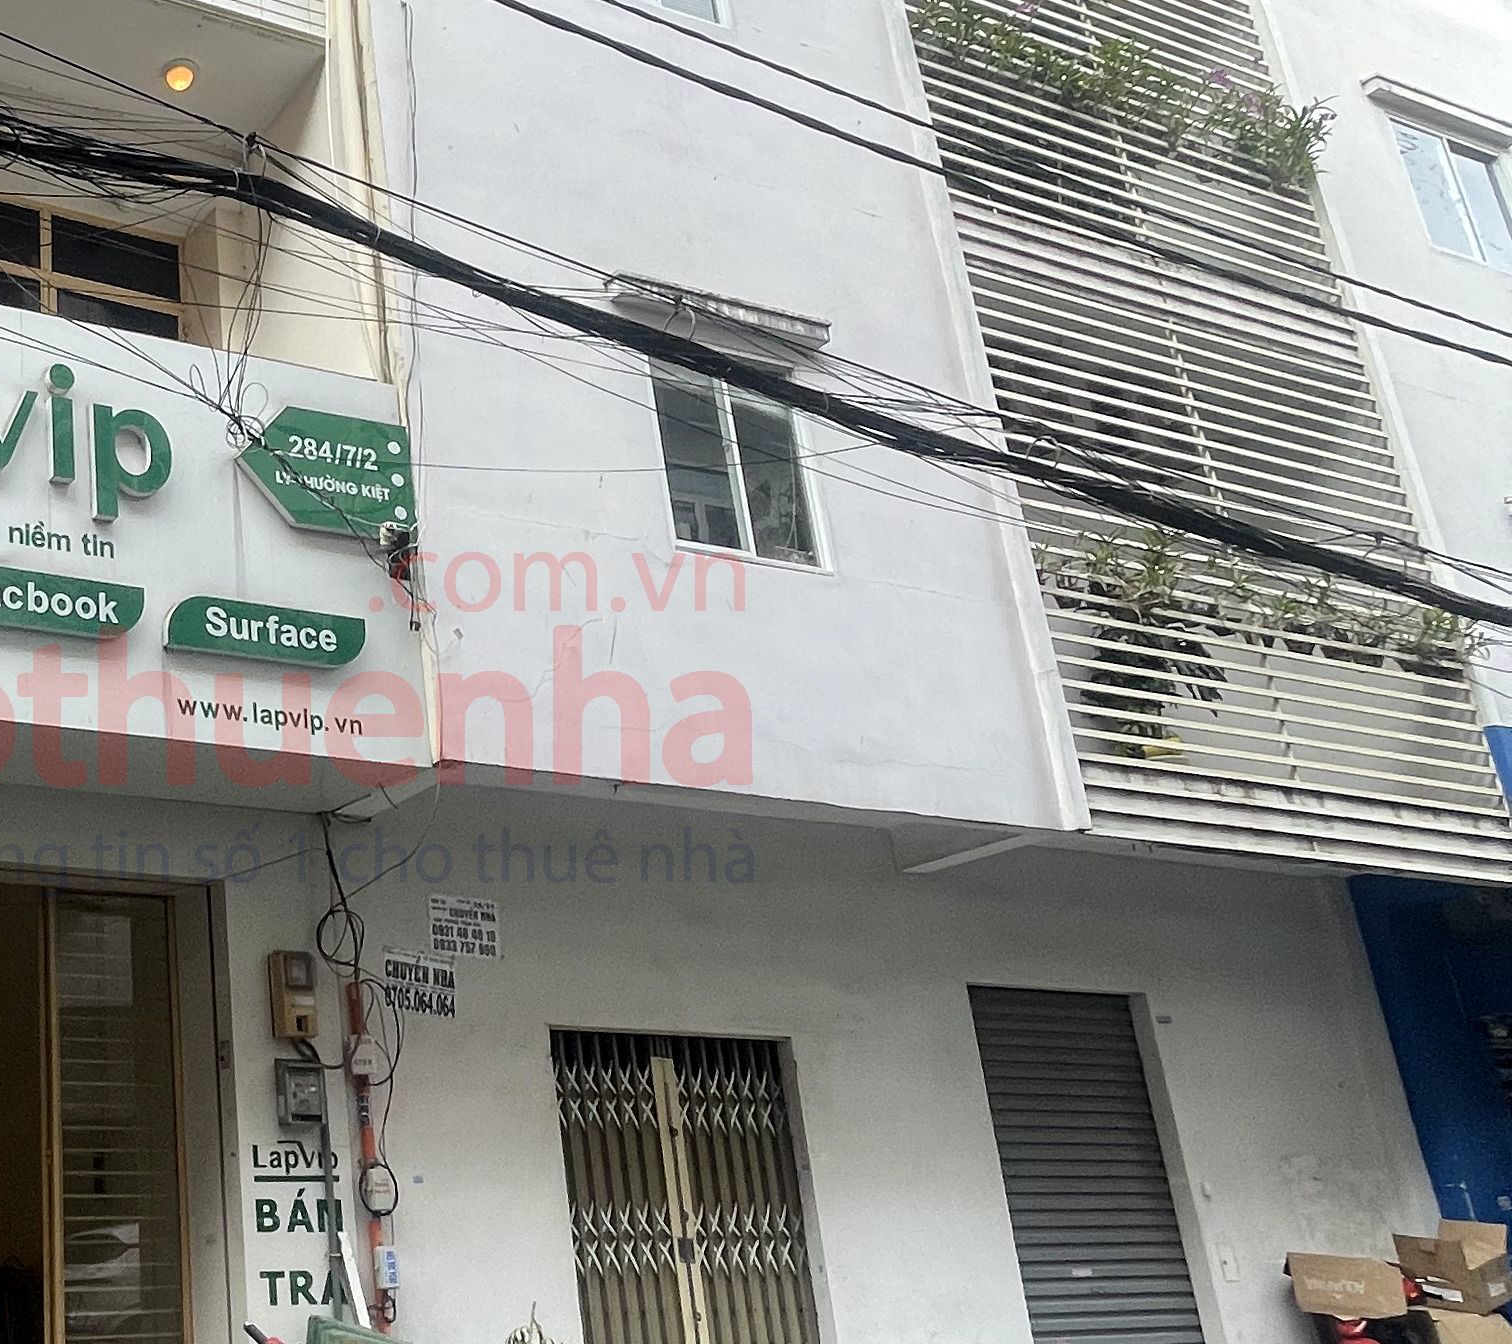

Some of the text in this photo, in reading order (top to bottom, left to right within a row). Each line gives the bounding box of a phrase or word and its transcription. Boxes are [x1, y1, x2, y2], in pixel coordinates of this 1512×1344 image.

[287, 435, 379, 472] 284/7/2
[361, 483, 392, 503] KIỆT
[8, 520, 72, 553] niềm
[81, 532, 116, 559] tin
[204, 605, 338, 653] Surface
